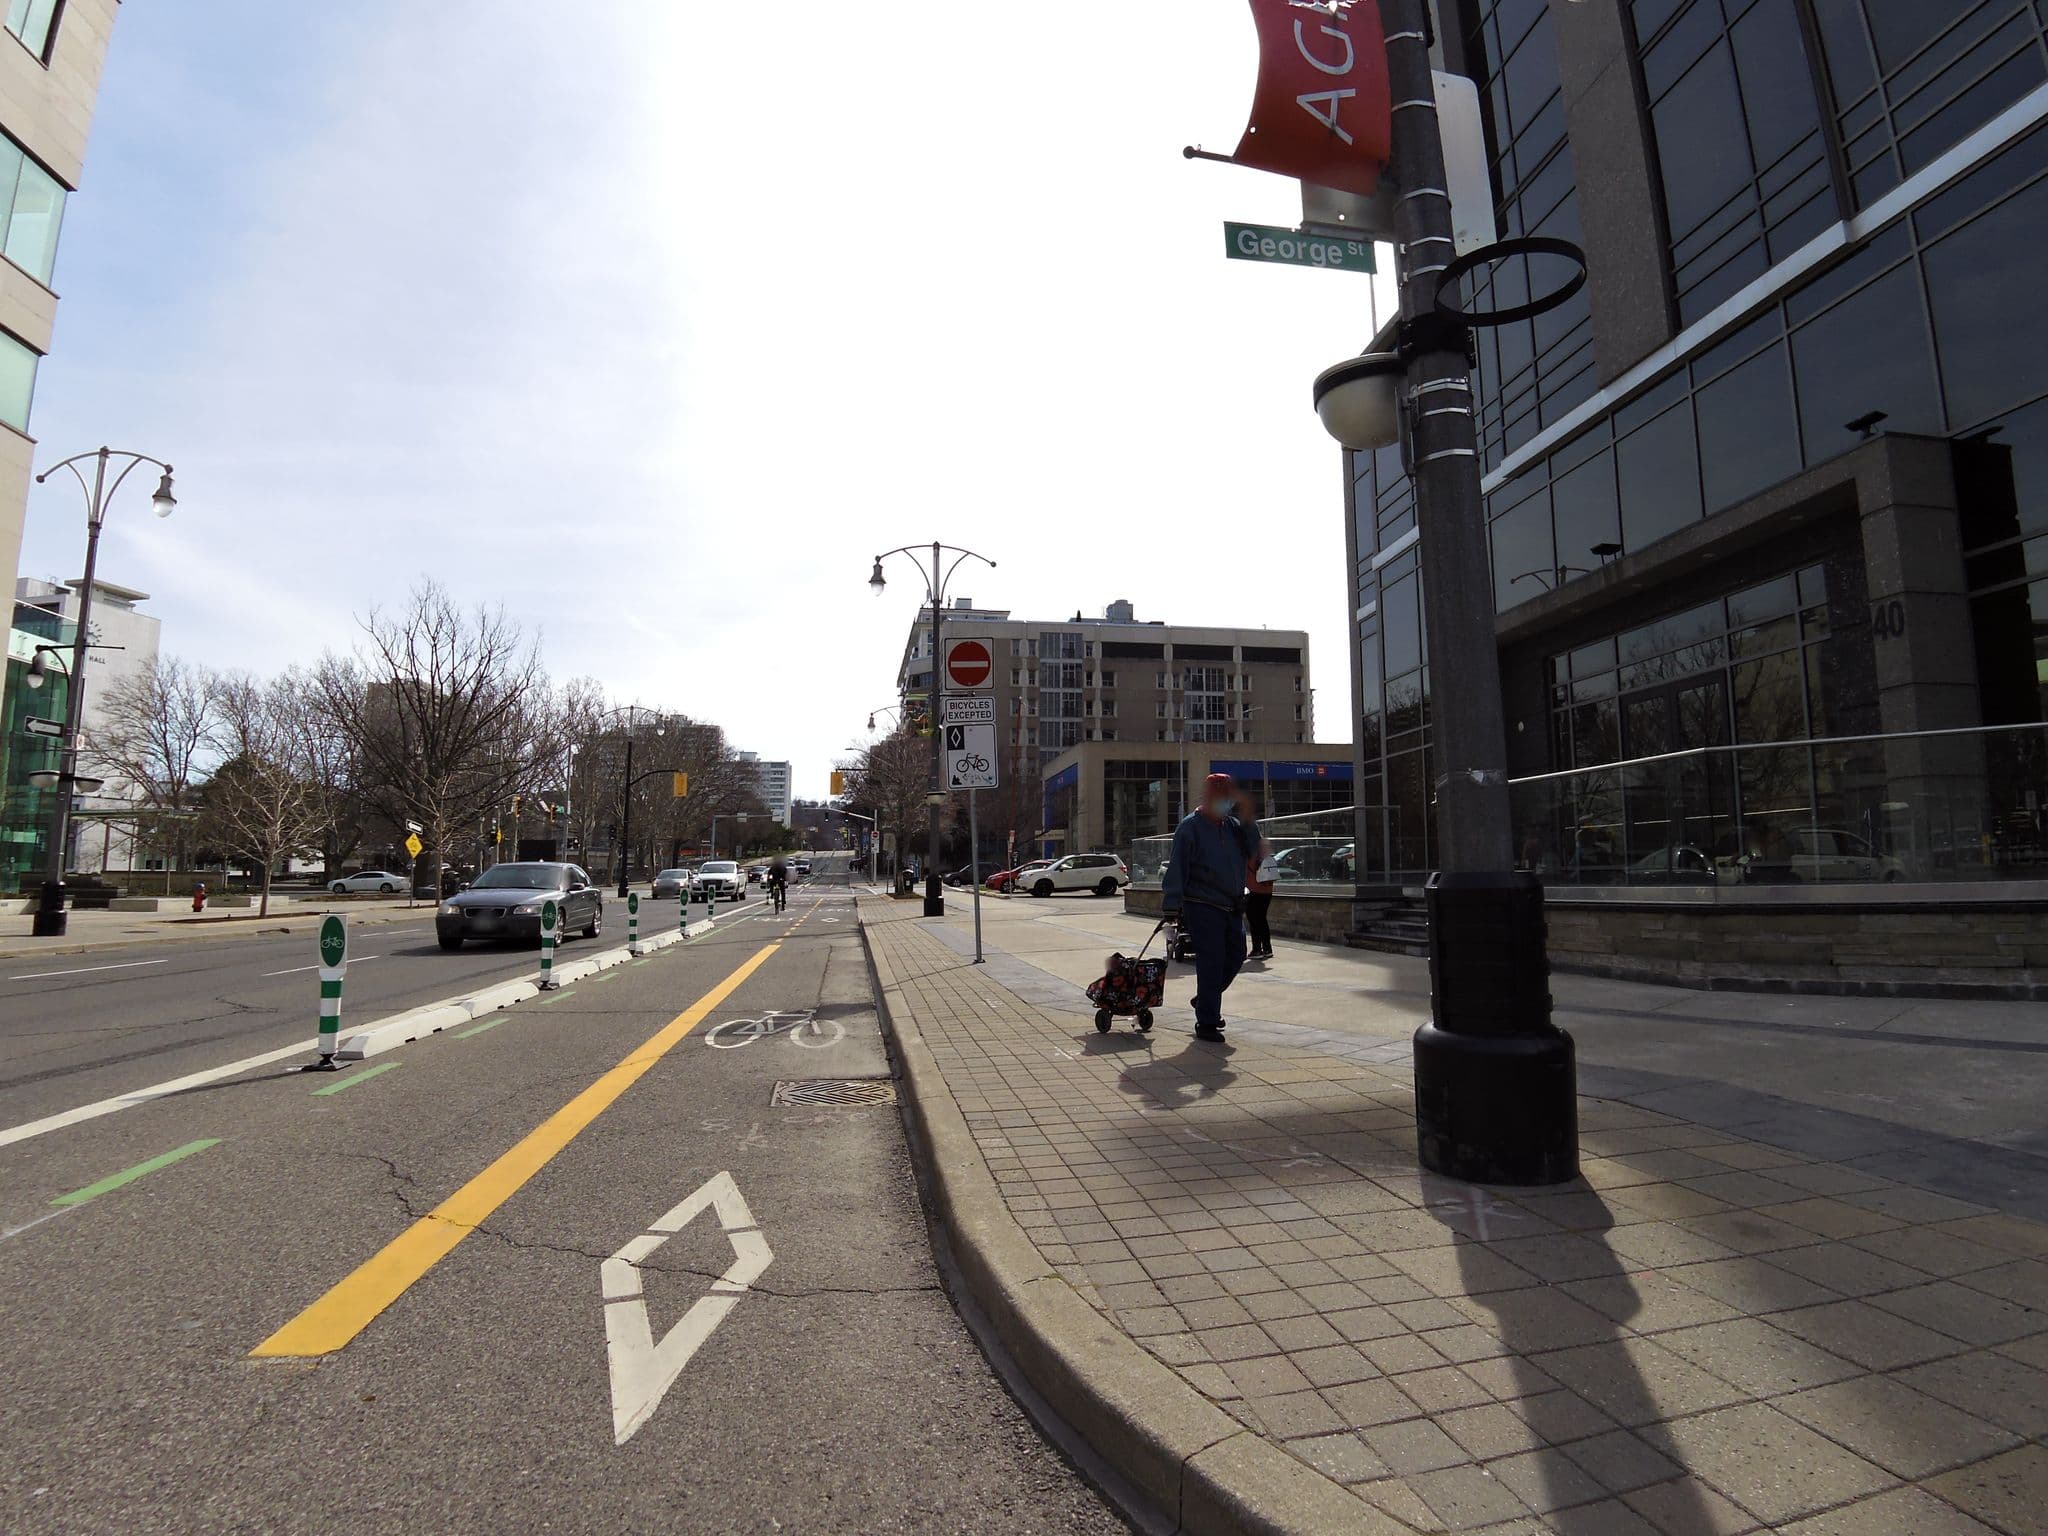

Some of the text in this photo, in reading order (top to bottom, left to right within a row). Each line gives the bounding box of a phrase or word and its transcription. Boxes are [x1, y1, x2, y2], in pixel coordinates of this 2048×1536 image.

[1237, 229, 1364, 267] George St
[1873, 601, 1905, 640] 40
[89, 655, 106, 665] HALL
[950, 701, 990, 710] BICYCLES
[948, 710, 992, 720] EXCEPTED
